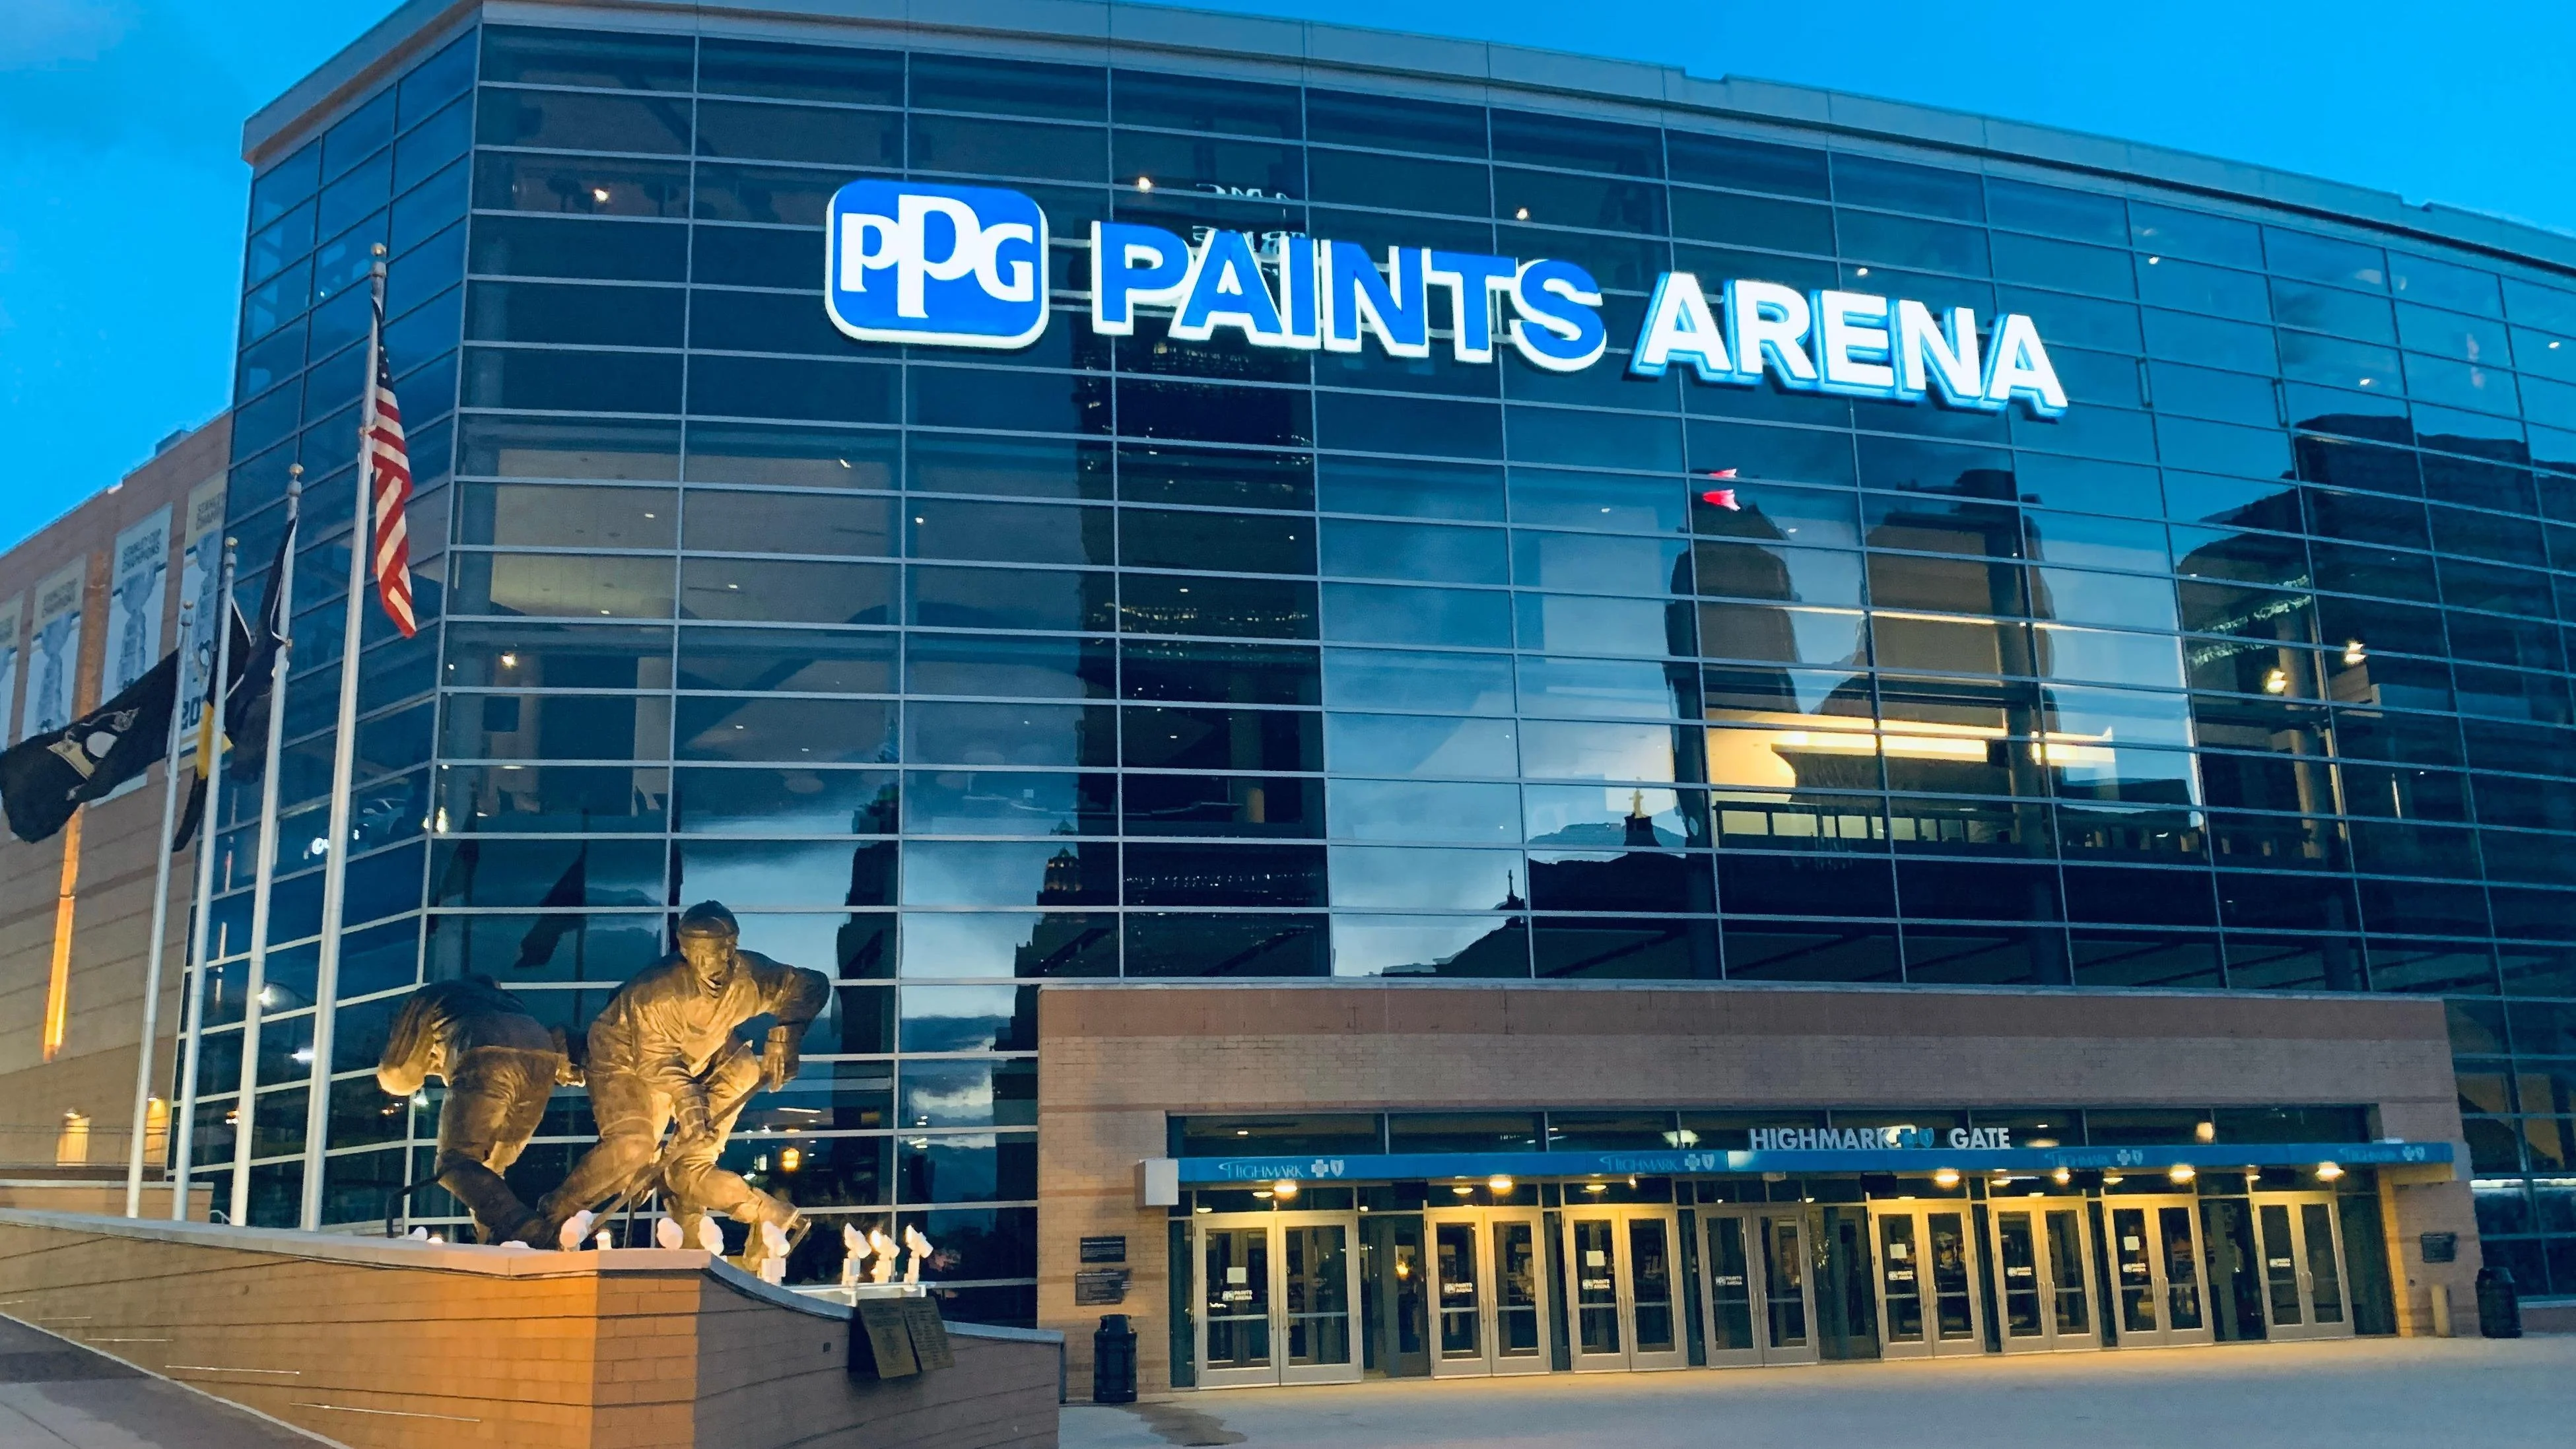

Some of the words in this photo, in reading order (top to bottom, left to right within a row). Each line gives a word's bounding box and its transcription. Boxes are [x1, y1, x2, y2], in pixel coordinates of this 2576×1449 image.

[840, 194, 1034, 318] PPG
[1091, 220, 1607, 372] PAINTS
[1630, 272, 2069, 418] ARENA
[1748, 1127, 1895, 1150] HIGHMARK
[1948, 1127, 2012, 1150] GATE
[1218, 1159, 1305, 1178] HIGHMARK
[1599, 1155, 1679, 1172] HIGHMARK
